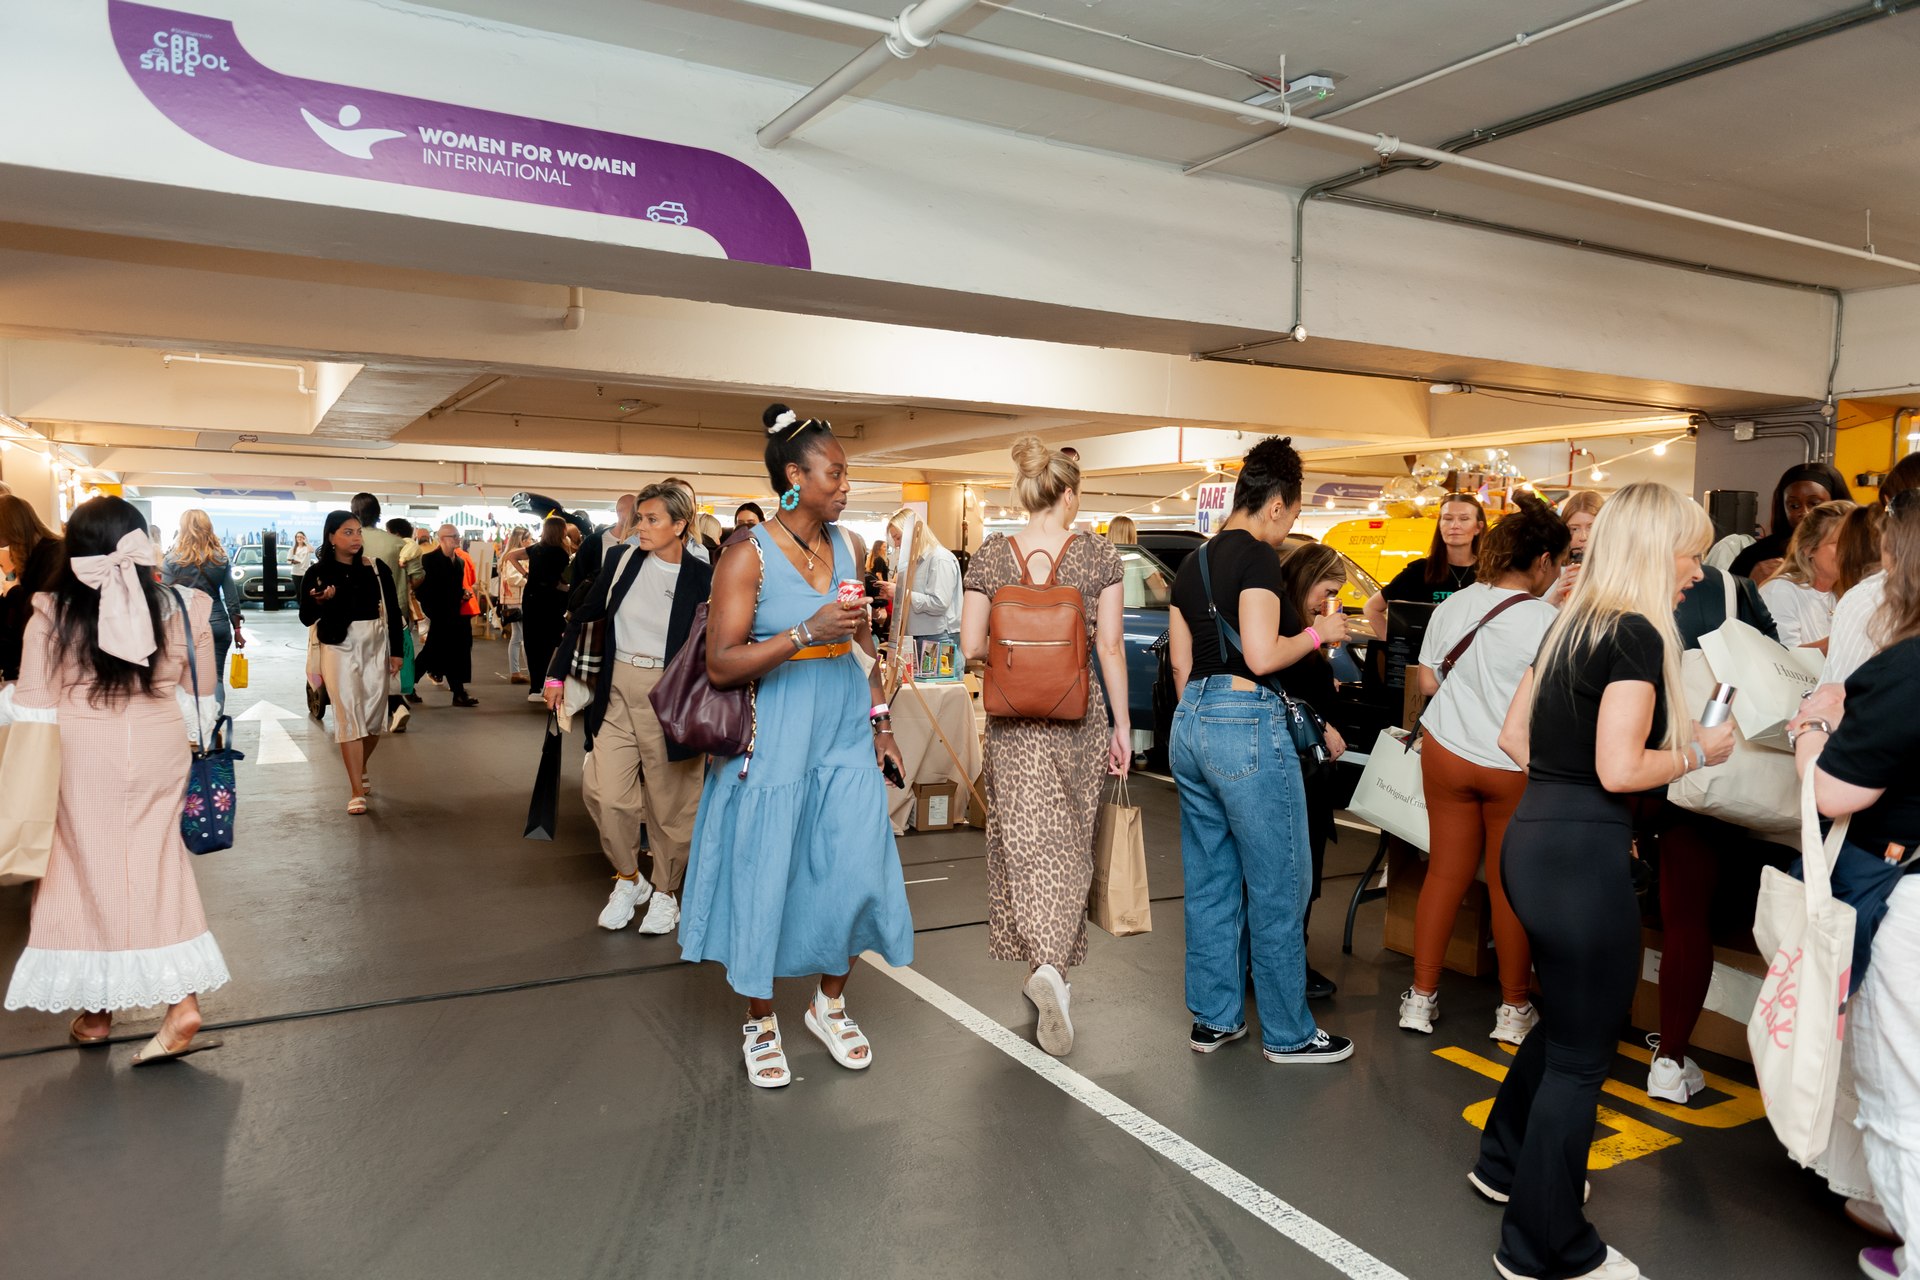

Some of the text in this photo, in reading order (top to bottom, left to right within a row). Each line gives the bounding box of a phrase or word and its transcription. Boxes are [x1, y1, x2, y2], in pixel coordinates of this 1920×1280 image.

[140, 53, 196, 77] SALE
[418, 126, 636, 178] WOMEN FOR WOMEN
[422, 148, 572, 187] INTERNATIONAL
[1199, 487, 1227, 510] DARE
[1376, 777, 1387, 790] The
[1386, 784, 1411, 803] Original
